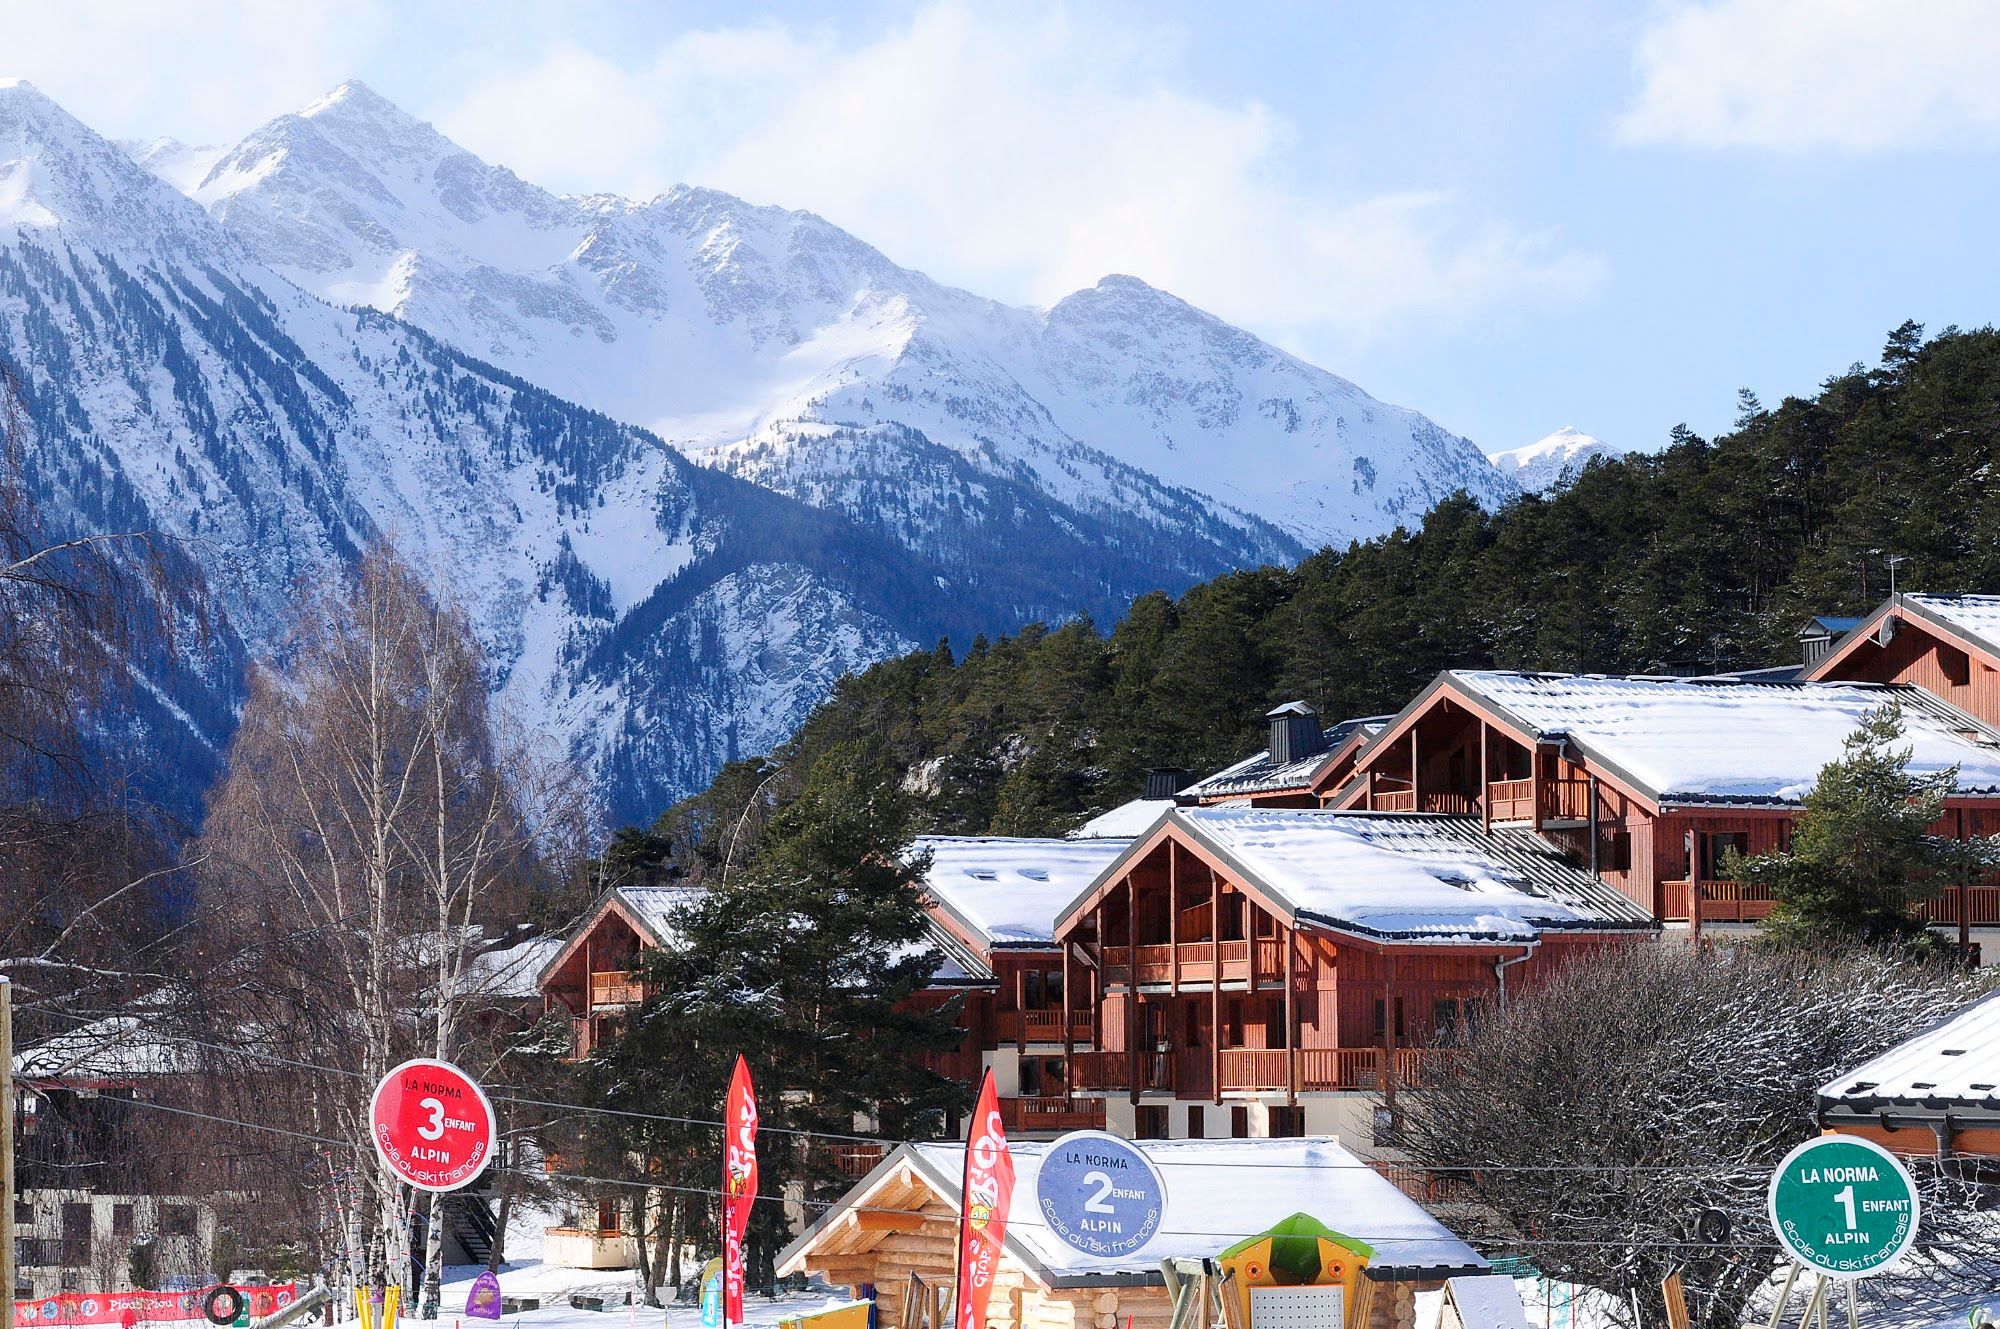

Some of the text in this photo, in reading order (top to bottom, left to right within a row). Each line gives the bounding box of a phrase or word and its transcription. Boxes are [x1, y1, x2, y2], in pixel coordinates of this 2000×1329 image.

[405, 1078, 462, 1099] LA NORMA
[417, 1097, 476, 1141] 3 ENFANT
[378, 1123, 485, 1182] école du ski français
[411, 1146, 450, 1164] ALPIN
[1066, 1152, 1128, 1169] LA NORMA
[1801, 1167, 1879, 1184] LA NORMA
[1083, 1170, 1146, 1214] 2 ENFANT
[1834, 1185, 1909, 1230] 1 ENFANT
[1042, 1198, 1157, 1253] école du ski français
[1081, 1219, 1122, 1233] ALPIN
[1783, 1212, 1909, 1270] école du ski français
[1825, 1232, 1870, 1244] ALPIN
